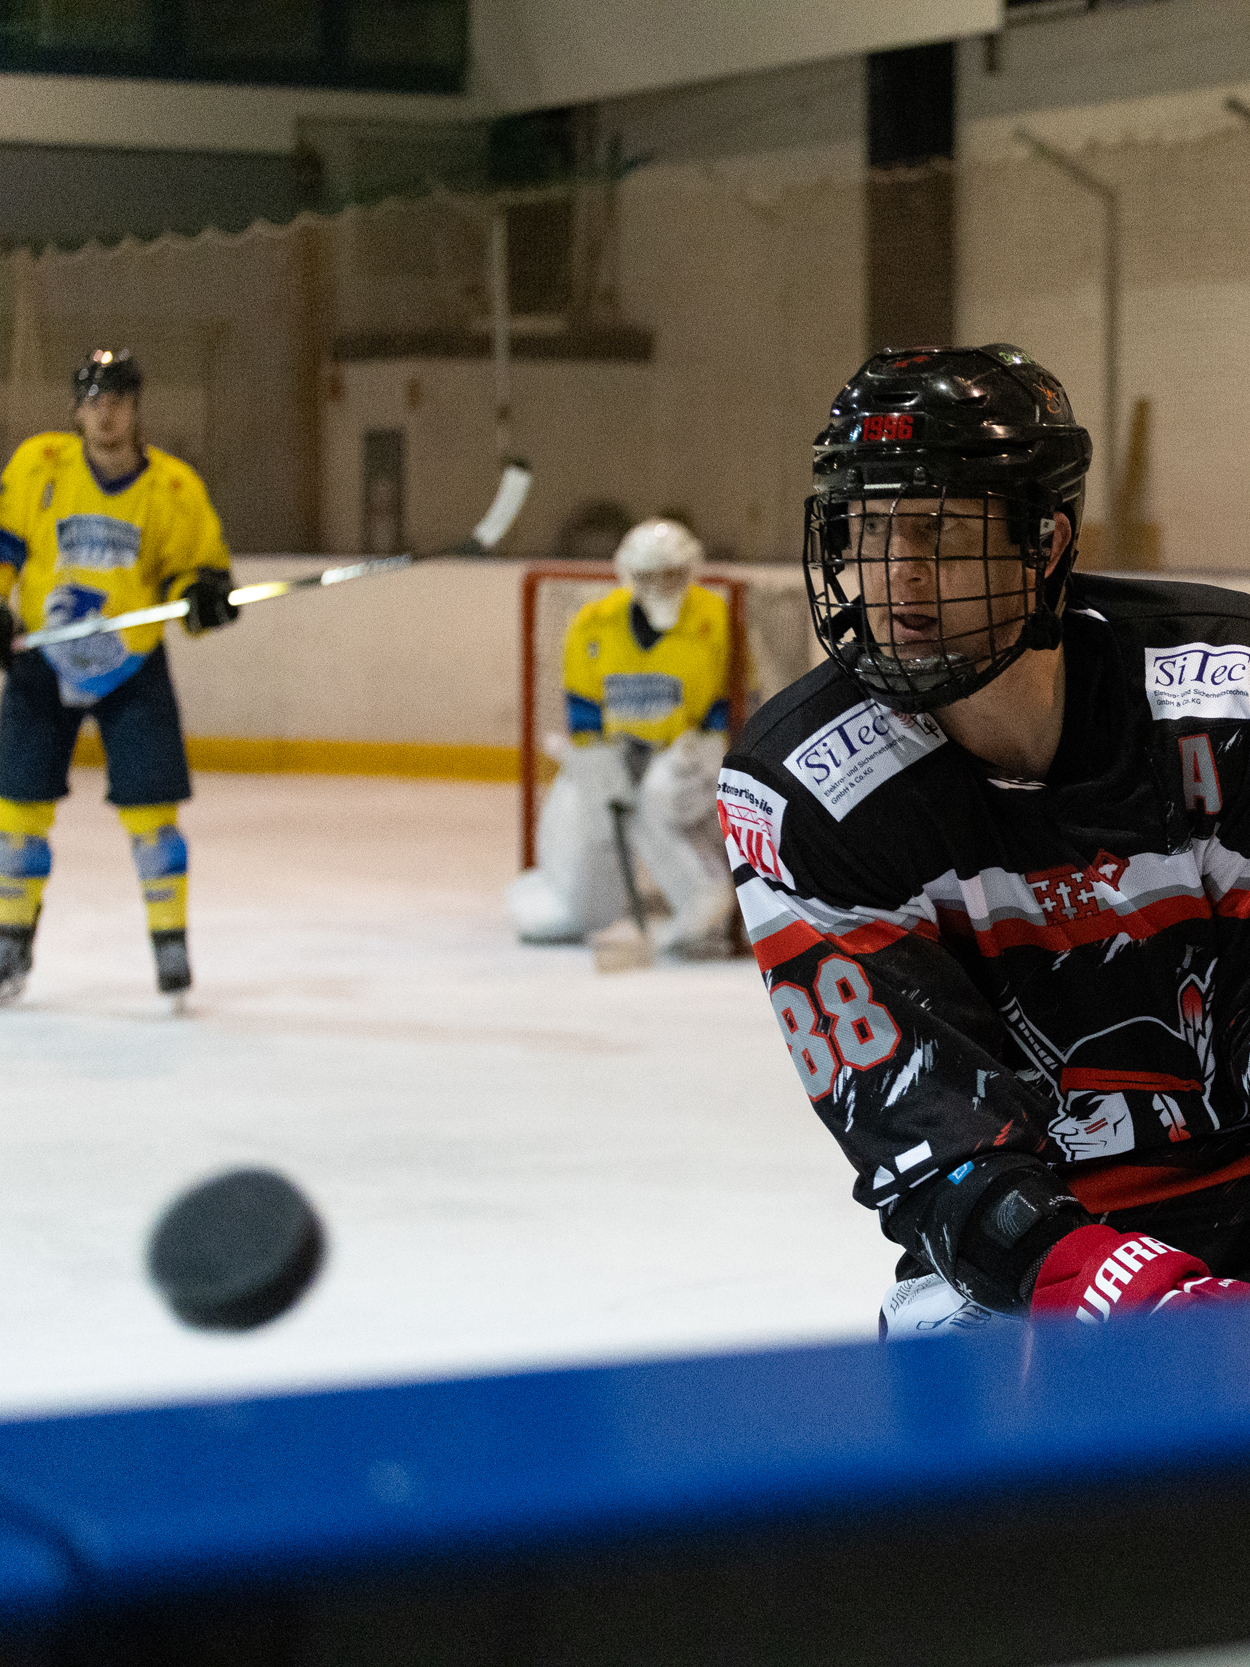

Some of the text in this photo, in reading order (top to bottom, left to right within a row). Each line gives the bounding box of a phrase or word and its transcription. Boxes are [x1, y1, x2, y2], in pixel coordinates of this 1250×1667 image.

[863, 414, 914, 441] 1996
[796, 702, 890, 786] SiTec
[846, 764, 859, 778] und
[1178, 733, 1223, 815] A
[770, 953, 902, 1102] 88
